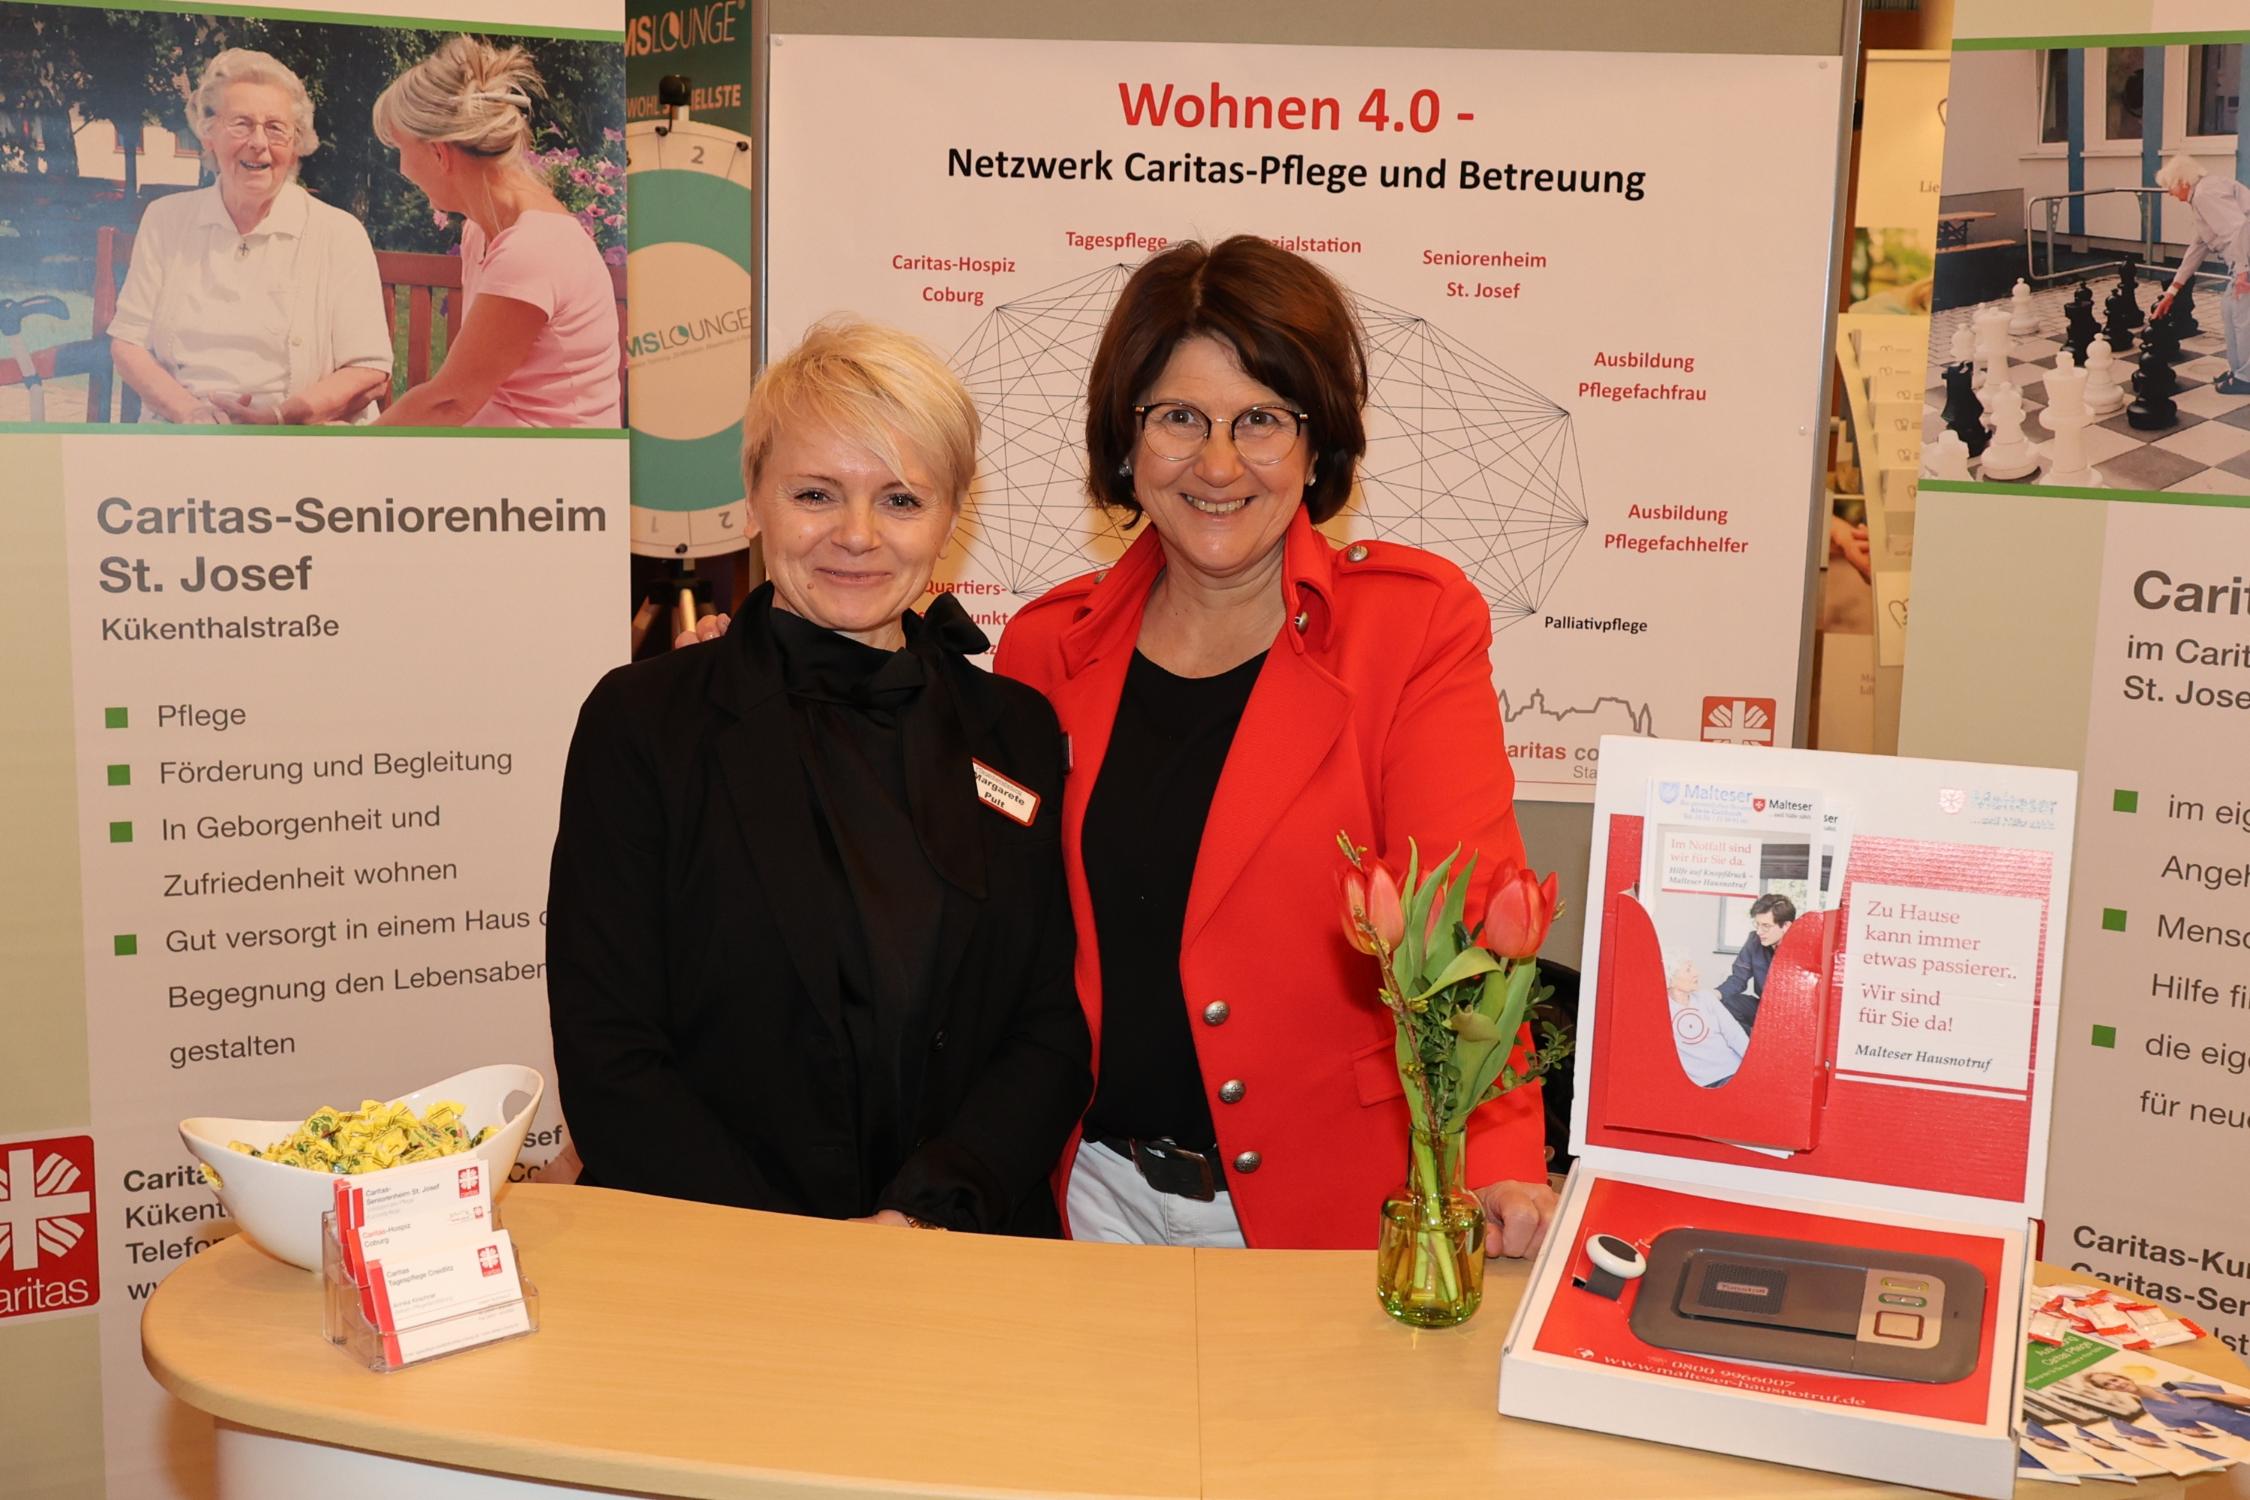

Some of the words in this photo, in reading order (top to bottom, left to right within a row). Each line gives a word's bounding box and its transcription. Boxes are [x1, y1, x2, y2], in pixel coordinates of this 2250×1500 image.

[1119, 82, 1340, 131] Wohnen
[1359, 88, 1440, 133] 4.0
[690, 146, 704, 164] 2
[948, 148, 1113, 180] Netzwerk
[1125, 152, 1367, 193] Caritas-Pflege
[1380, 158, 1447, 190] und
[1459, 160, 1646, 201] Betreuung
[1065, 231, 1167, 252] Tagespflege
[1270, 235, 1361, 253] zialstation
[892, 254, 1016, 275] Caritas-Hospiz
[1422, 248, 1547, 269] Seniorenheim
[922, 285, 984, 307] Coburg
[1446, 281, 1469, 299] St.
[1474, 282, 1521, 299] Josef
[1593, 351, 1695, 373] Ausbildung
[1578, 382, 1707, 402] Pflegefachfrau
[97, 497, 606, 535] Caritas-Seniorenheim
[1628, 504, 1728, 525] Ausbildung
[1604, 533, 1749, 554] Pflegefachhelfer
[99, 556, 164, 593] St.
[180, 556, 312, 592] Josef
[101, 614, 339, 641] Kükenthalstraße
[971, 610, 1008, 625] unkt
[1544, 615, 1648, 633] Palliativpflege
[2127, 634, 2164, 661] im
[2123, 674, 2164, 702] St.
[2175, 680, 2250, 710] Jose
[157, 704, 246, 731] Pflege
[1506, 741, 1567, 760] aritas
[159, 757, 303, 785] Förderung
[313, 753, 363, 778] und
[373, 749, 512, 778] Begleitung
[975, 772, 1025, 805] Margarete
[1684, 784, 1753, 803] Malteser
[1769, 799, 1813, 812] Malteser
[2169, 794, 2204, 821] im
[161, 817, 186, 841] In
[196, 808, 382, 842] Geborgenheit
[391, 805, 440, 829] und
[1728, 844, 1752, 854] sind
[164, 865, 345, 897] Zufriedenheit
[354, 861, 457, 886] wohnen
[1867, 900, 1893, 918] Zu
[1900, 903, 1960, 924] Hause
[165, 927, 217, 954] Gut
[226, 920, 336, 951] versorgt
[346, 917, 368, 942] in
[377, 913, 455, 938] einem
[466, 910, 530, 931] Haus
[1866, 925, 1912, 945] kann
[1918, 930, 1981, 951] immer
[1863, 953, 1917, 969] etwas
[168, 978, 326, 1011] Begegnung
[335, 972, 384, 997] den
[1861, 983, 1895, 1001] Wir
[1900, 988, 1941, 1006] sind
[2151, 973, 2219, 1005] Hilfe
[1858, 1007, 1887, 1024] für
[1891, 1010, 1919, 1028] Sie
[1925, 1015, 1953, 1032] da!
[169, 1033, 296, 1068] gestalten
[1855, 1044, 1913, 1062] Malteser
[1915, 1050, 1992, 1072] Hausnotruf
[2145, 1033, 2190, 1060] die
[2201, 1043, 2250, 1075] eig
[2140, 1090, 2180, 1118] für
[2190, 1103, 2250, 1129] neu
[2073, 1225, 2250, 1279] Caritas-Ku
[0, 1277, 89, 1314] aritas
[1603, 1355, 1867, 1406] www.malteser-hausnotruf.de
[1671, 1360, 1715, 1376] 0800
